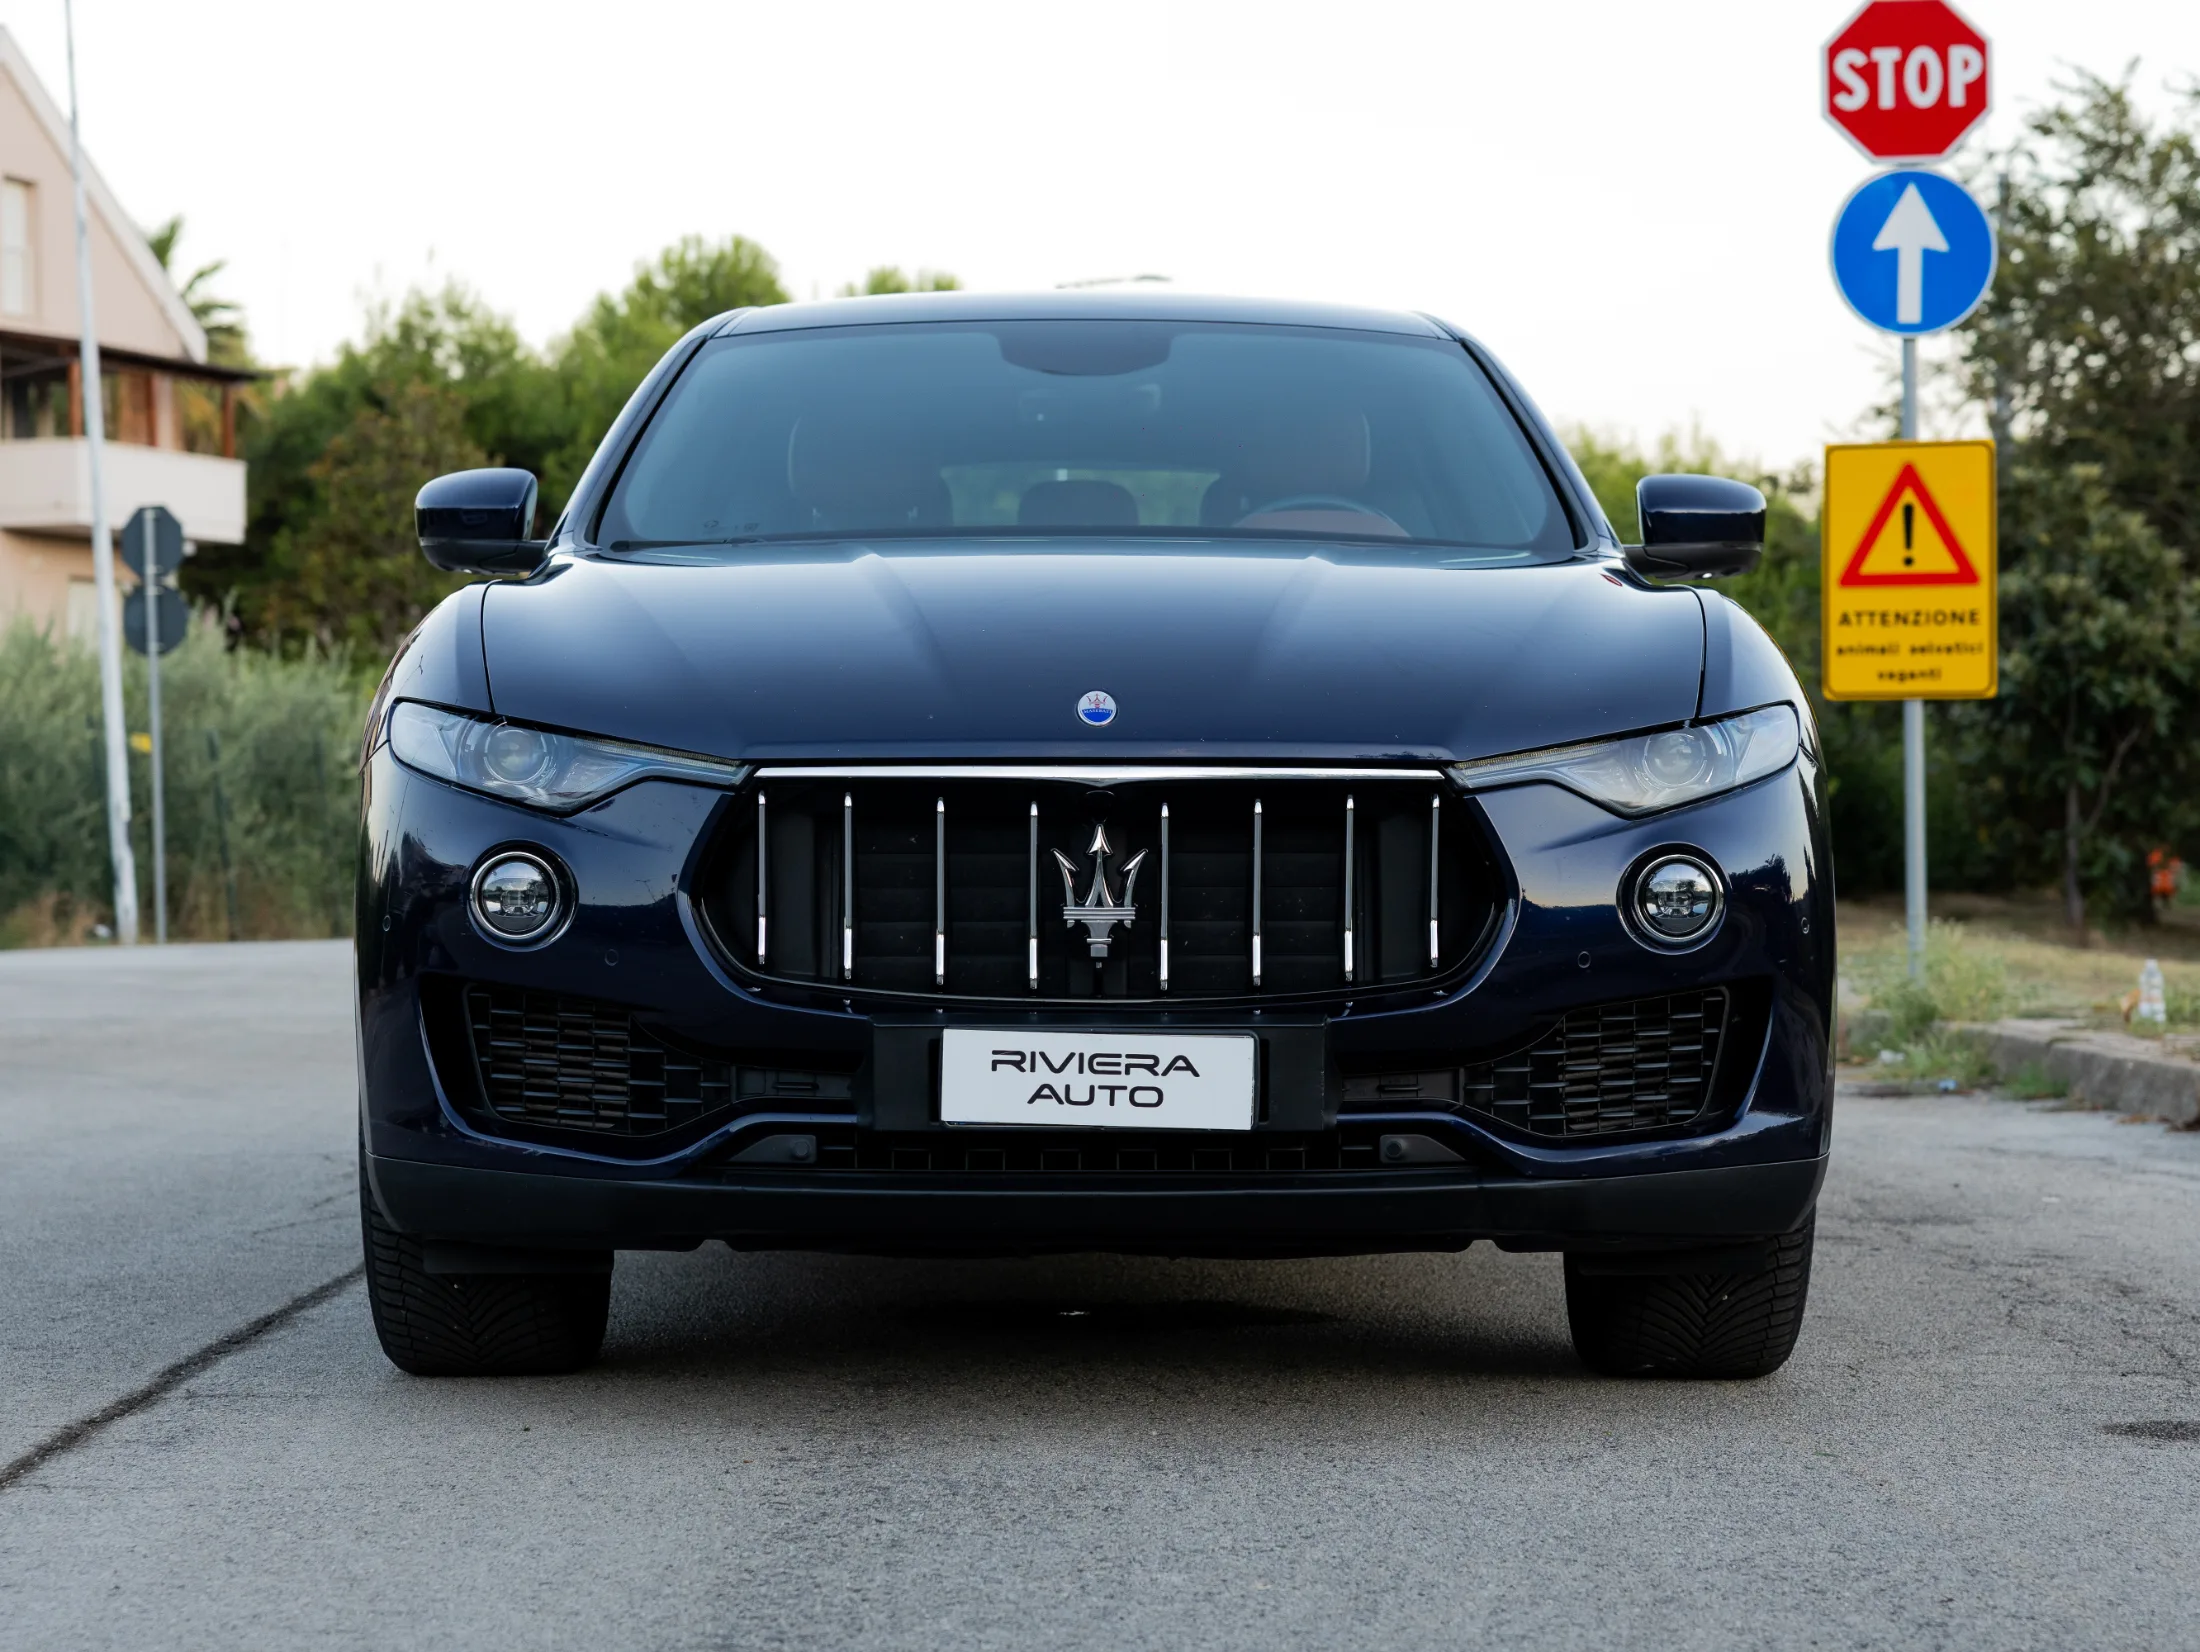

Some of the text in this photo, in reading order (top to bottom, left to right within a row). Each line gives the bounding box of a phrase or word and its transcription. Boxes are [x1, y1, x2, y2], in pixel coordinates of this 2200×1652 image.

[1833, 43, 1984, 112] STOP
[1838, 609, 1981, 627] ATTENZIONE
[1836, 642, 1900, 656] animali
[1876, 667, 1943, 684] vaganti
[991, 1050, 1200, 1077] RIVIERA
[1027, 1083, 1164, 1108] AUTO
